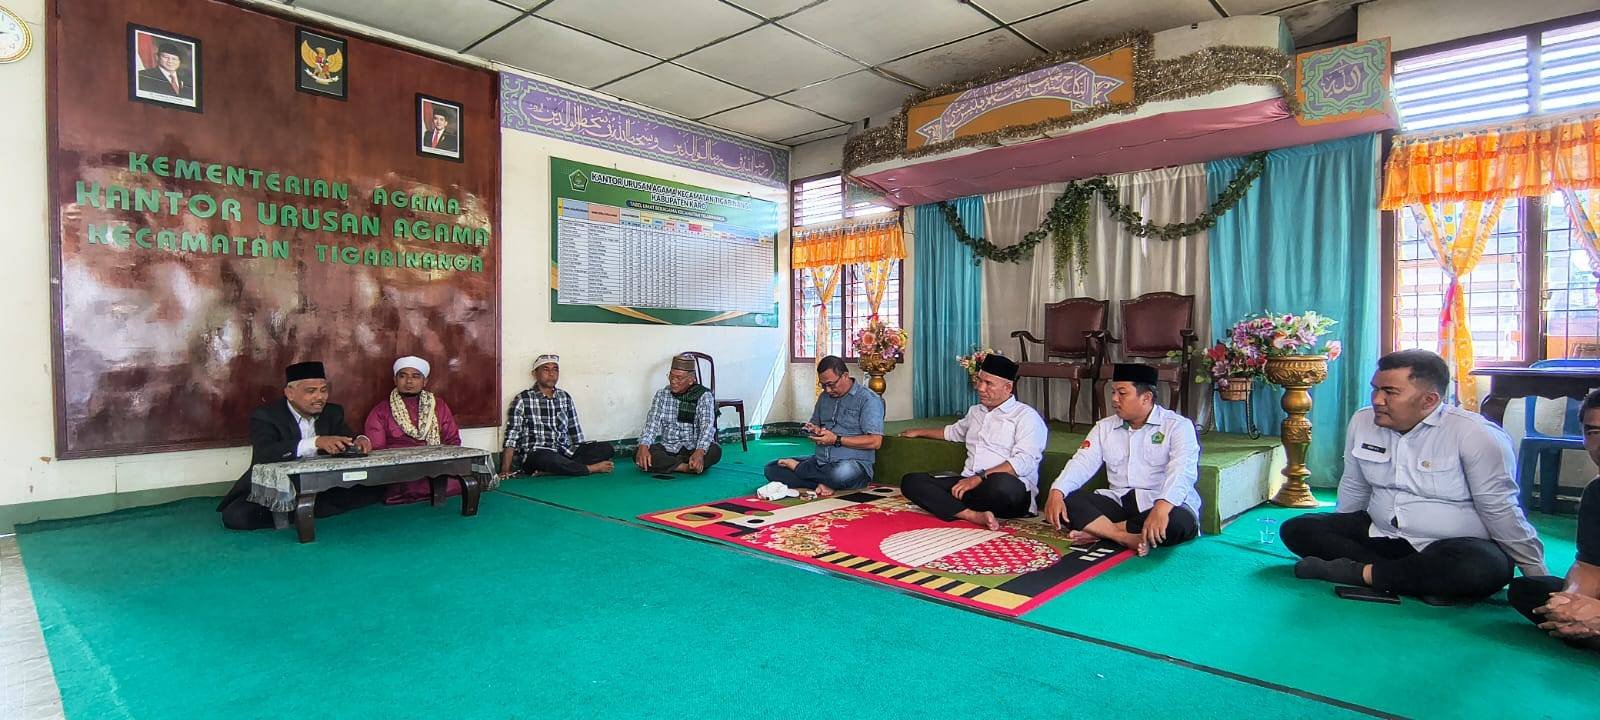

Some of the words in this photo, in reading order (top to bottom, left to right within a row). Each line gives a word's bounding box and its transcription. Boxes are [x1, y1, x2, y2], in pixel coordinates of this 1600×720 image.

[1321, 59, 1361, 98] الله
[128, 151, 349, 201] KEMENTERIAN
[372, 187, 460, 215] AGAMA
[591, 171, 623, 187] KANTOR
[622, 178, 652, 192] URUSAN
[652, 184, 678, 197] AGAMA
[677, 190, 716, 204] KECAMATAN
[651, 193, 690, 208] KABUPATEN
[689, 200, 708, 211] KARO
[75, 180, 242, 222] KANTOR
[257, 202, 381, 237] URUSAN
[393, 218, 490, 247] AGAMA
[87, 223, 290, 260] KECAMATAN
[314, 241, 484, 273] TIGABINANGA
